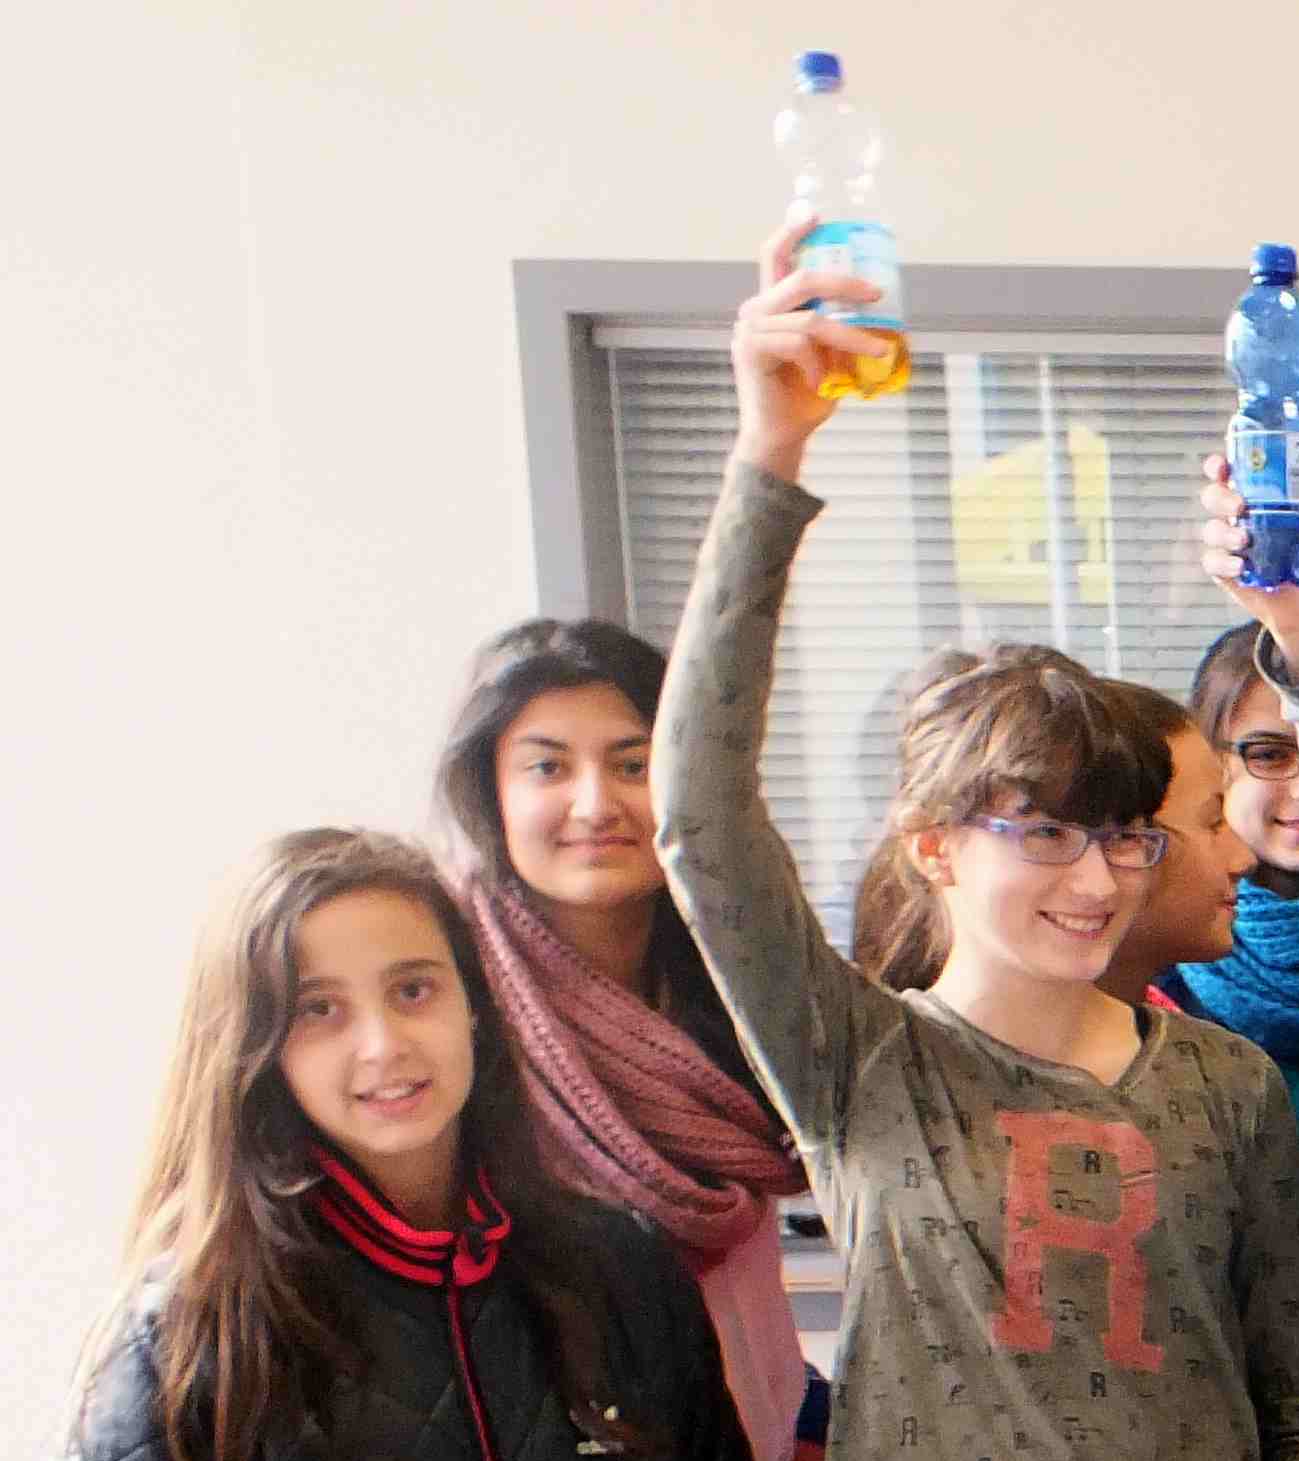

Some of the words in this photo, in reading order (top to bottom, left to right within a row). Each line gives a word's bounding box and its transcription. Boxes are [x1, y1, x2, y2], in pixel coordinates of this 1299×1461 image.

[1083, 1150, 1101, 1174] R
[991, 1111, 1165, 1374] R
[1091, 1371, 1106, 1397] R
